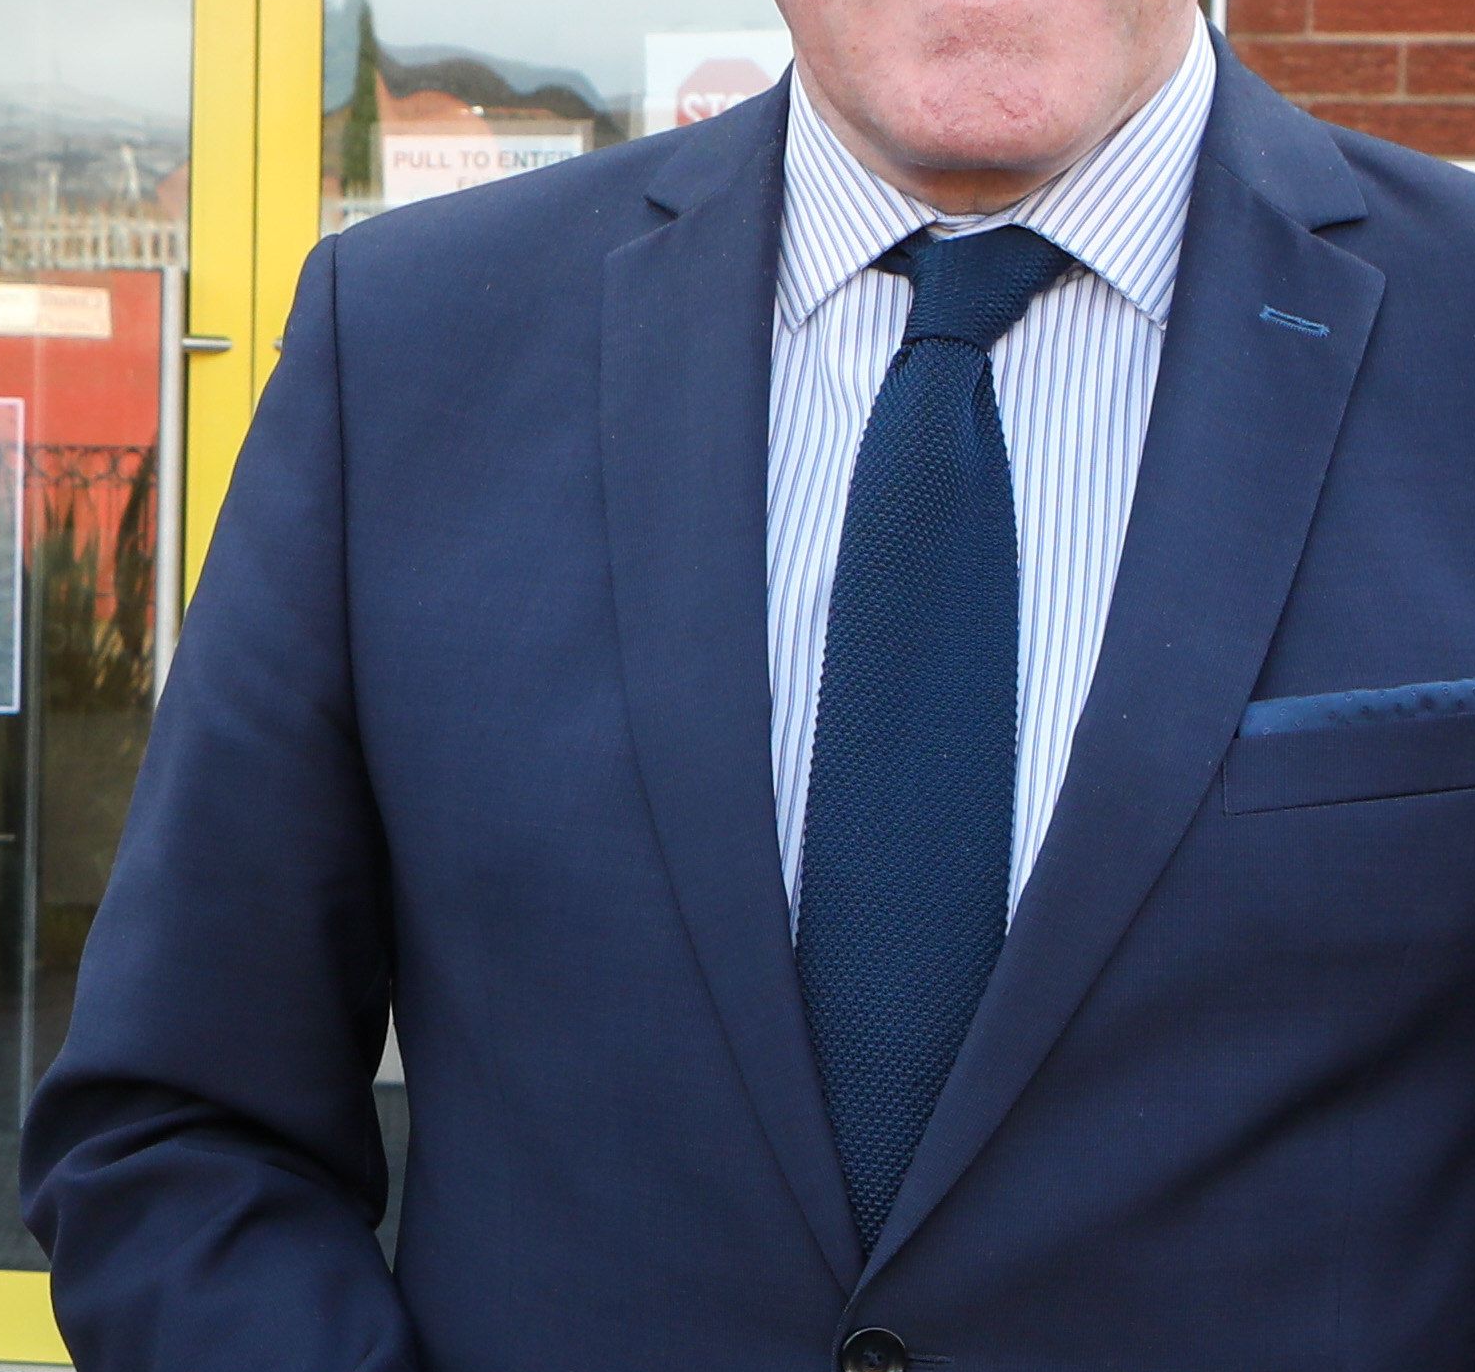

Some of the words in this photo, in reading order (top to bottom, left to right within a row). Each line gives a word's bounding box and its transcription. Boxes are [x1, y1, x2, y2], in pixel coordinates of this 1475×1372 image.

[682, 91, 748, 122] ST
[393, 150, 451, 168] PULL
[459, 150, 490, 168] TO
